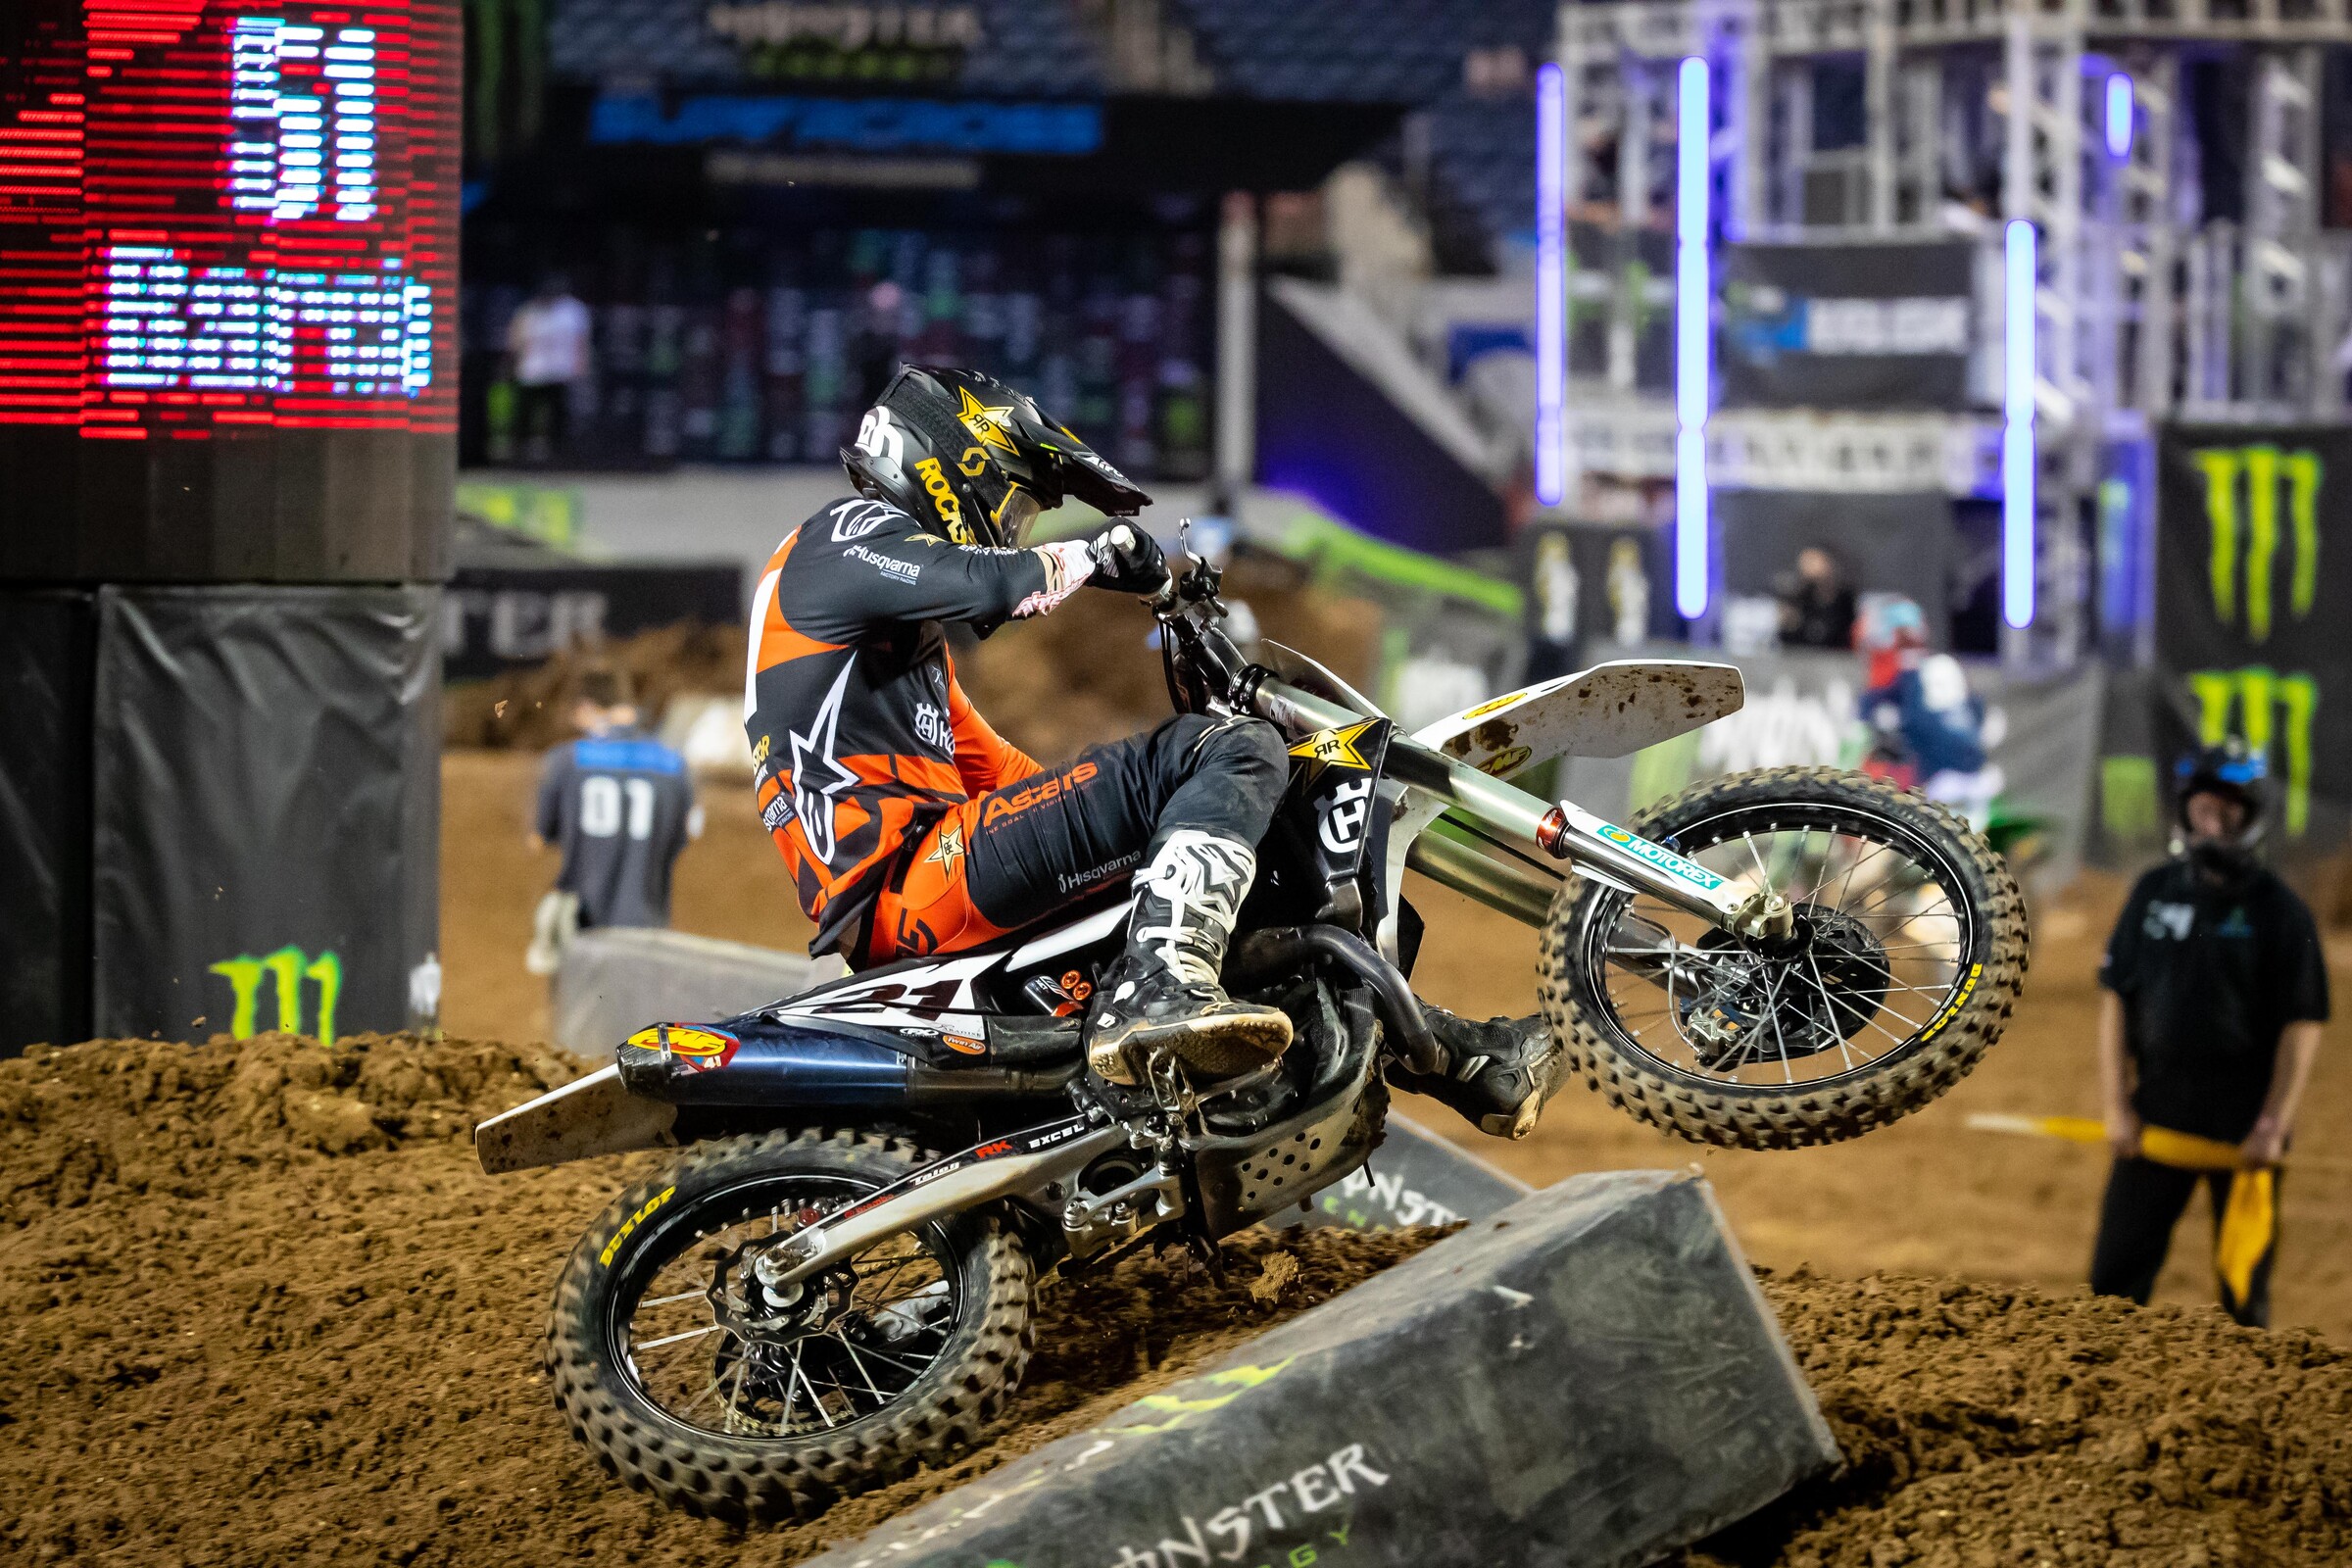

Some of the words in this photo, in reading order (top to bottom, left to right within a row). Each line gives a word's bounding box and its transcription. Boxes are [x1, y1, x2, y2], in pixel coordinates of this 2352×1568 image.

[229, 18, 376, 221] 51
[914, 457, 978, 545] ROCKS
[1627, 838, 1716, 888] MOTOREX
[628, 1029, 727, 1053] FMF
[947, 1036, 968, 1047] Twin
[968, 1041, 984, 1051] Air
[974, 1140, 1012, 1159] RK
[1028, 1123, 1085, 1151] EXCEL
